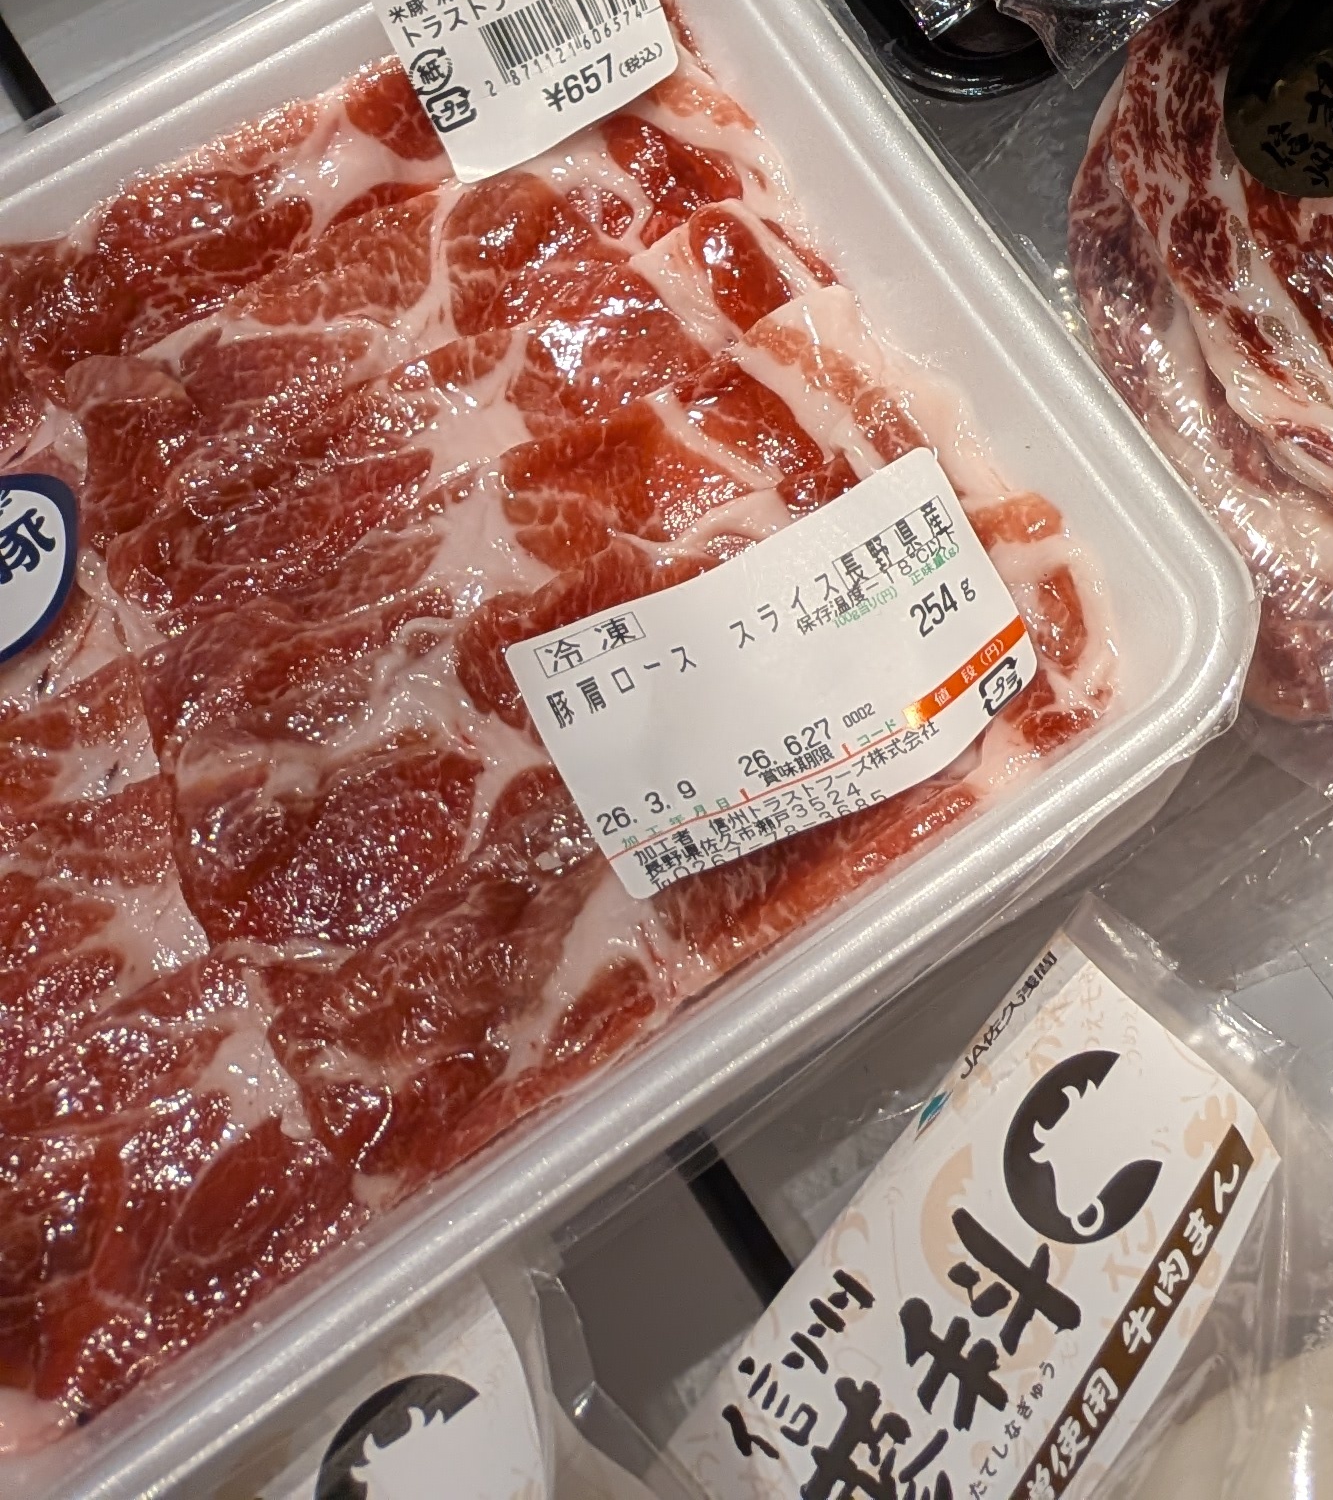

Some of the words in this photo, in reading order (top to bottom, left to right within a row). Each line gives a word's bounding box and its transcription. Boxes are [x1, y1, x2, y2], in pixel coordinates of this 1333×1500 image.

[543, 53, 615, 112] ¥657
[547, 645, 698, 728] 豚肩ロース
[728, 572, 839, 650] スライス
[910, 583, 958, 637] 254
[962, 578, 976, 601] g
[759, 744, 835, 786] 賞味期限
[843, 703, 876, 729] 0002
[633, 829, 694, 866] 加工者
[708, 721, 939, 835] 信州トラストフーズ株式会社
[1121, 1163, 1240, 1357] 牛肉まん
[722, 1269, 874, 1459] 信州
[969, 1361, 1056, 1499] たてしなぎゅう
